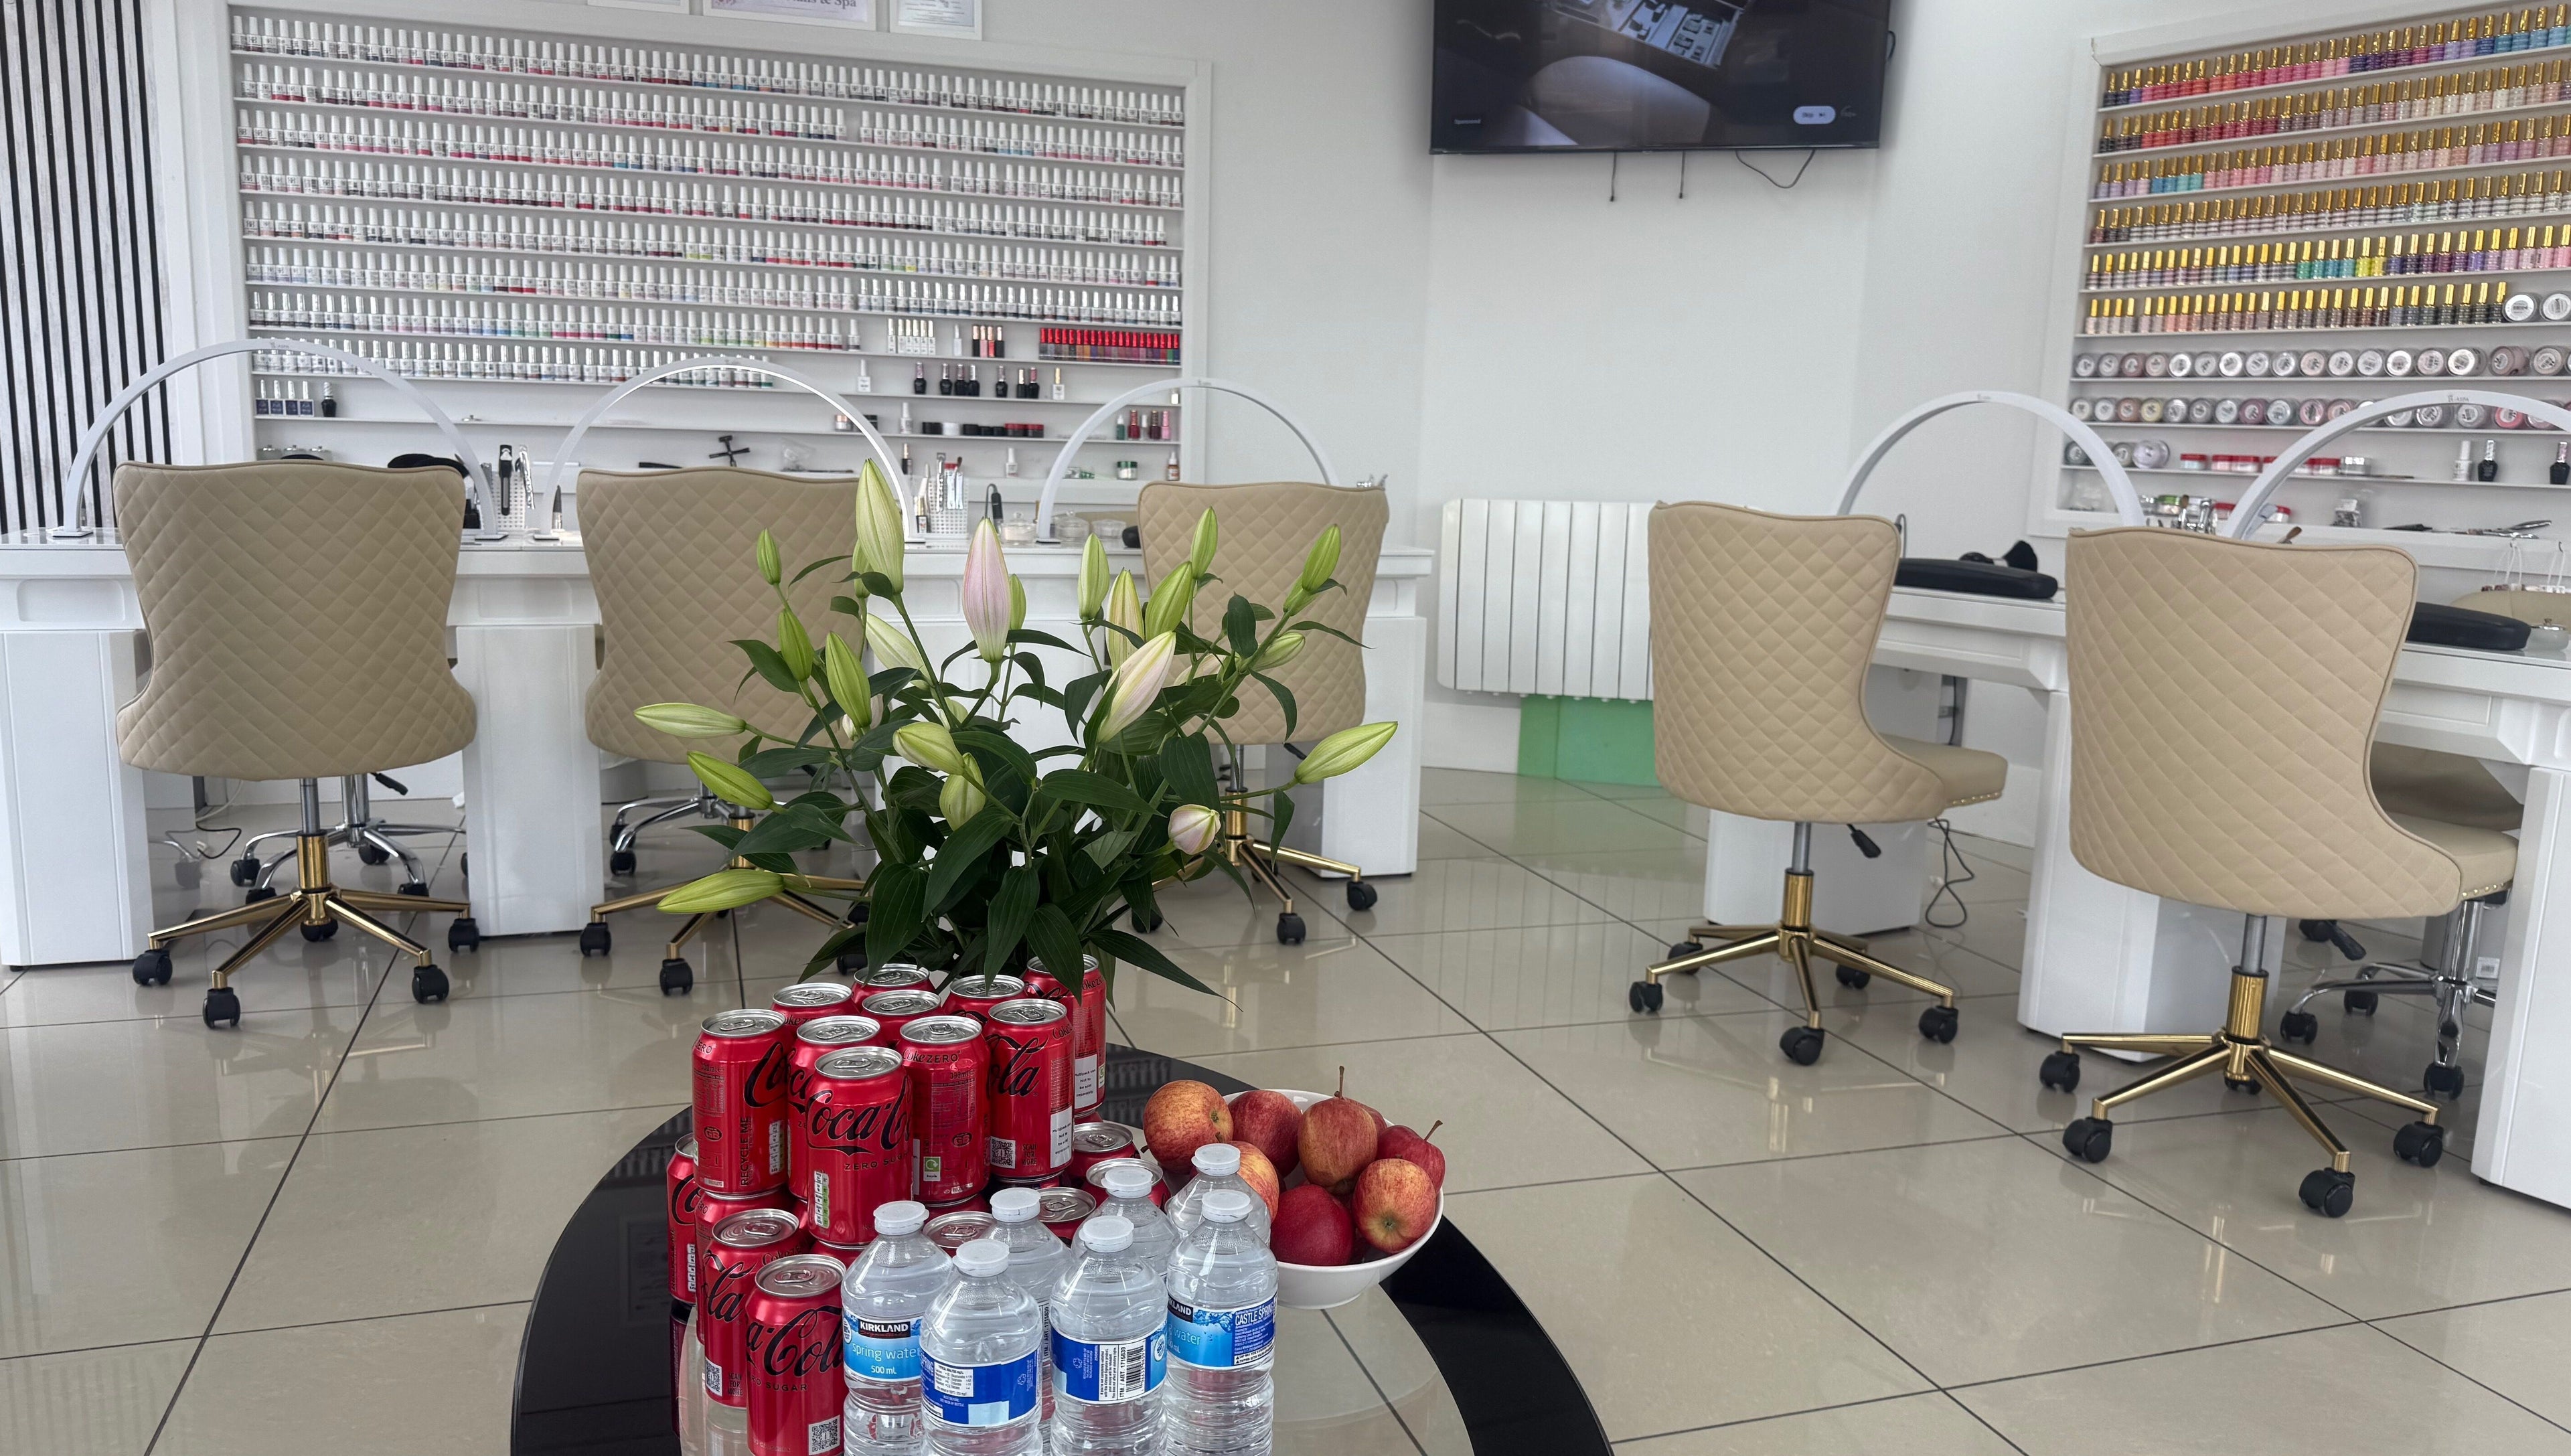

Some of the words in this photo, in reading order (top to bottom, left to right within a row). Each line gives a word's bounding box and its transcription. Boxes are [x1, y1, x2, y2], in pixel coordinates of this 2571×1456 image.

[740, 1117, 749, 1133] ME
[740, 1137, 749, 1186] RECYCLE
[844, 1161, 878, 1171] ZERO
[1235, 1311, 1257, 1326] CASTLE
[860, 1321, 909, 1333] KIRKLAND
[1174, 1329, 1202, 1346] water
[852, 1342, 882, 1362] spring
[871, 1365, 884, 1374] 500
[886, 1366, 897, 1374] mL
[767, 1382, 807, 1391] SUGAR
